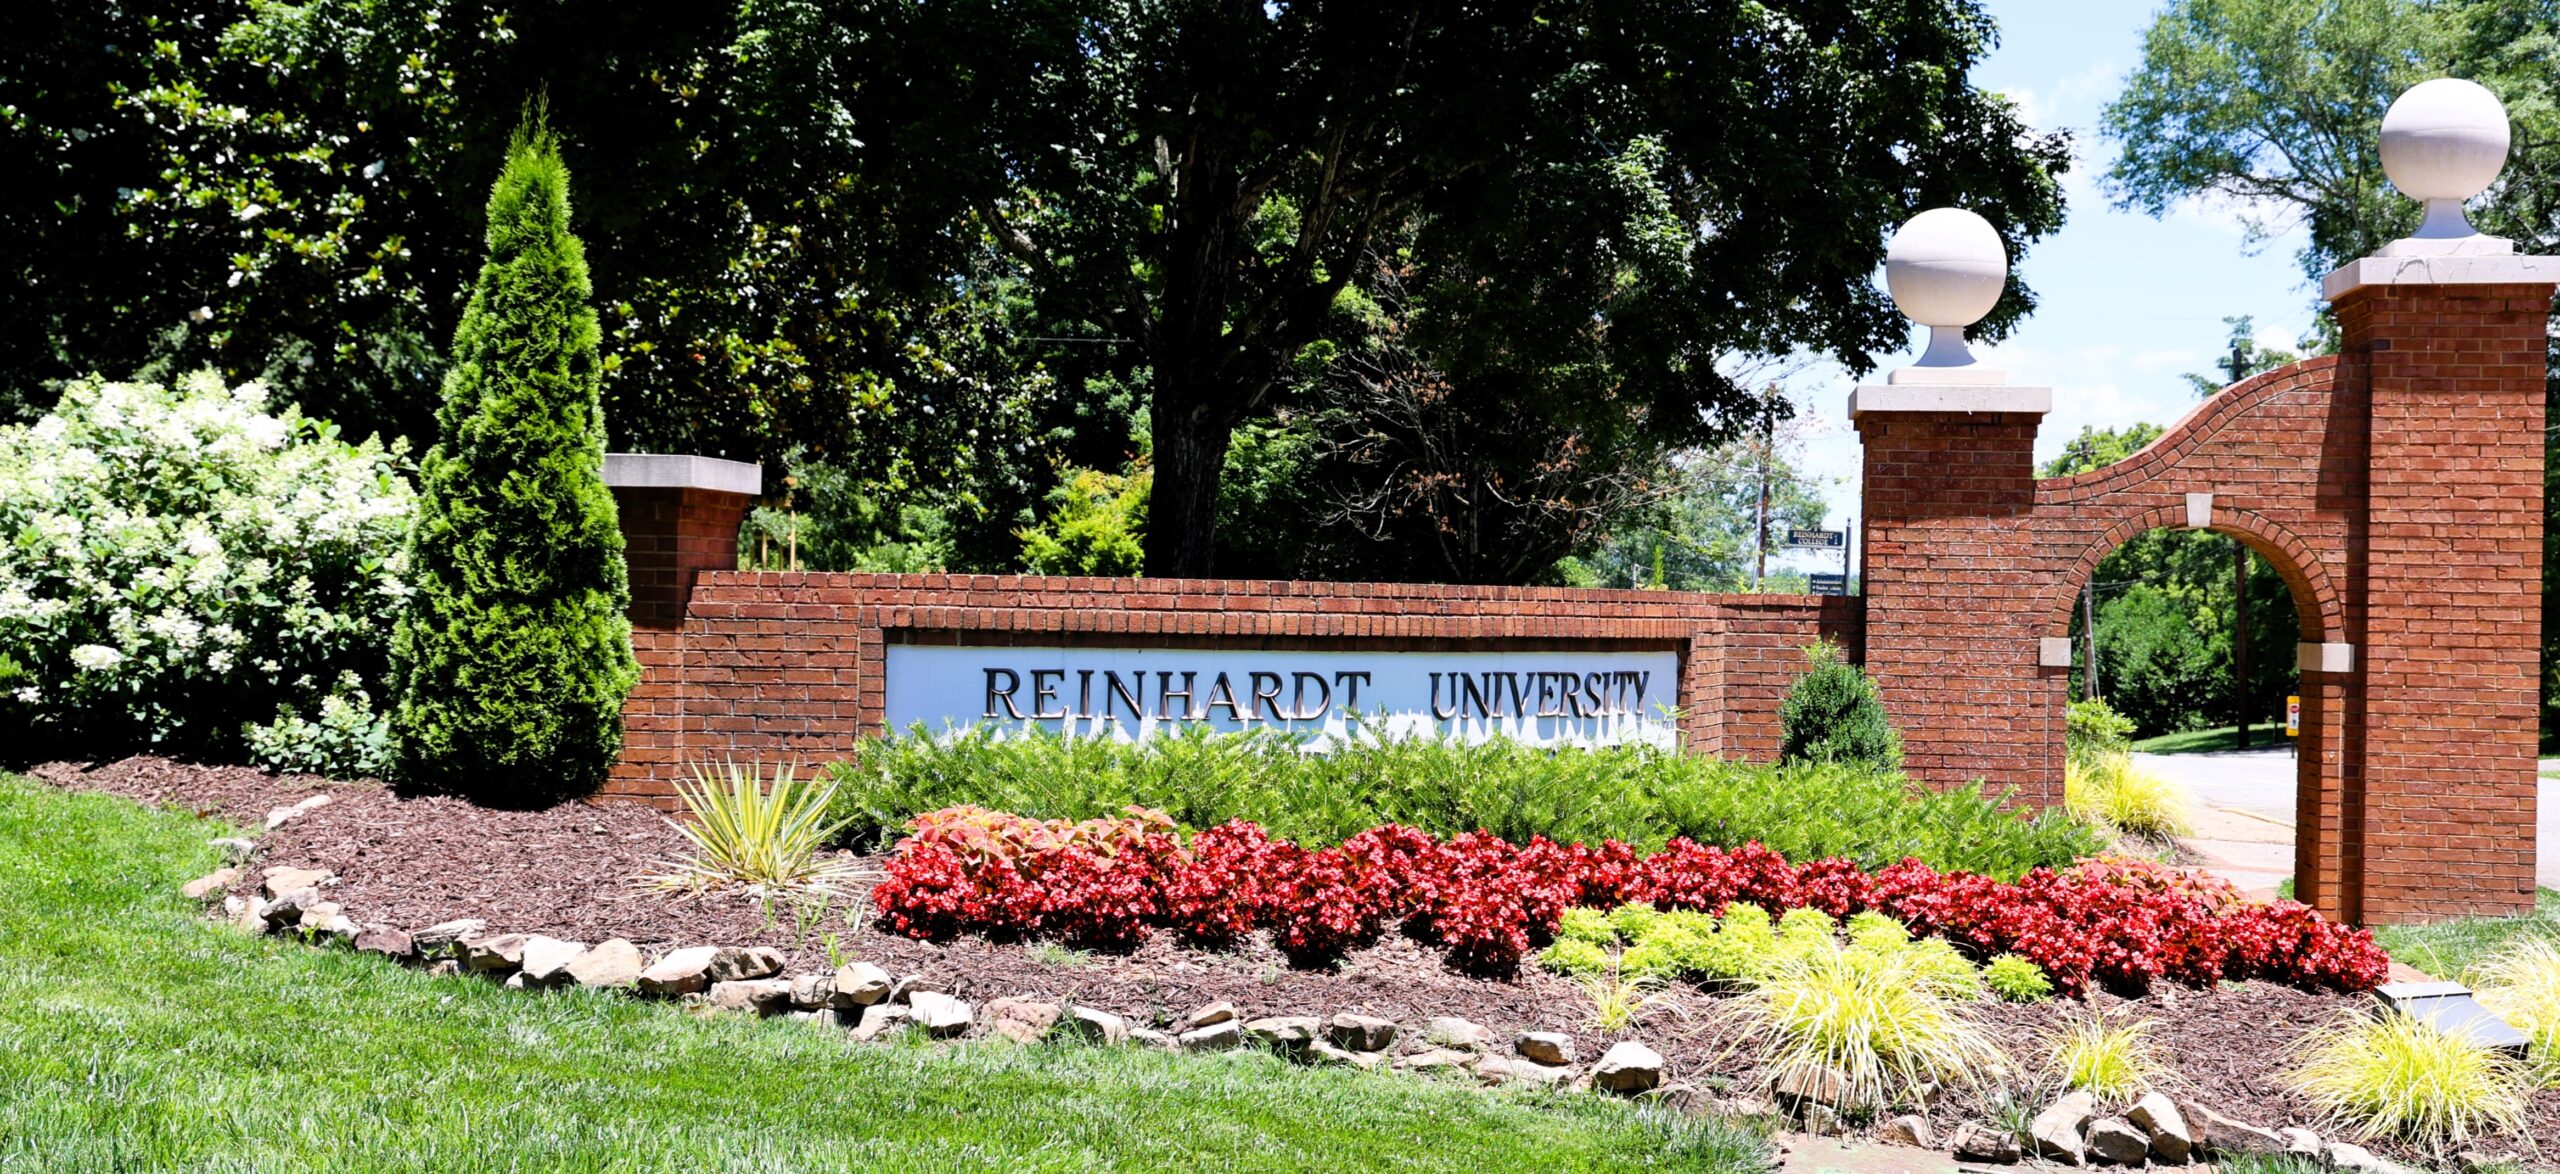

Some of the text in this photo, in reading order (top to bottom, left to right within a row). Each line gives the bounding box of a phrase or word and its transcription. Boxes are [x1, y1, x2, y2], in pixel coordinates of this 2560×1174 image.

[1793, 531, 1834, 539] REINHARDT
[1798, 538, 1828, 546] COLLEGE
[981, 667, 1650, 721] REINHARDT UNIVERSITY
